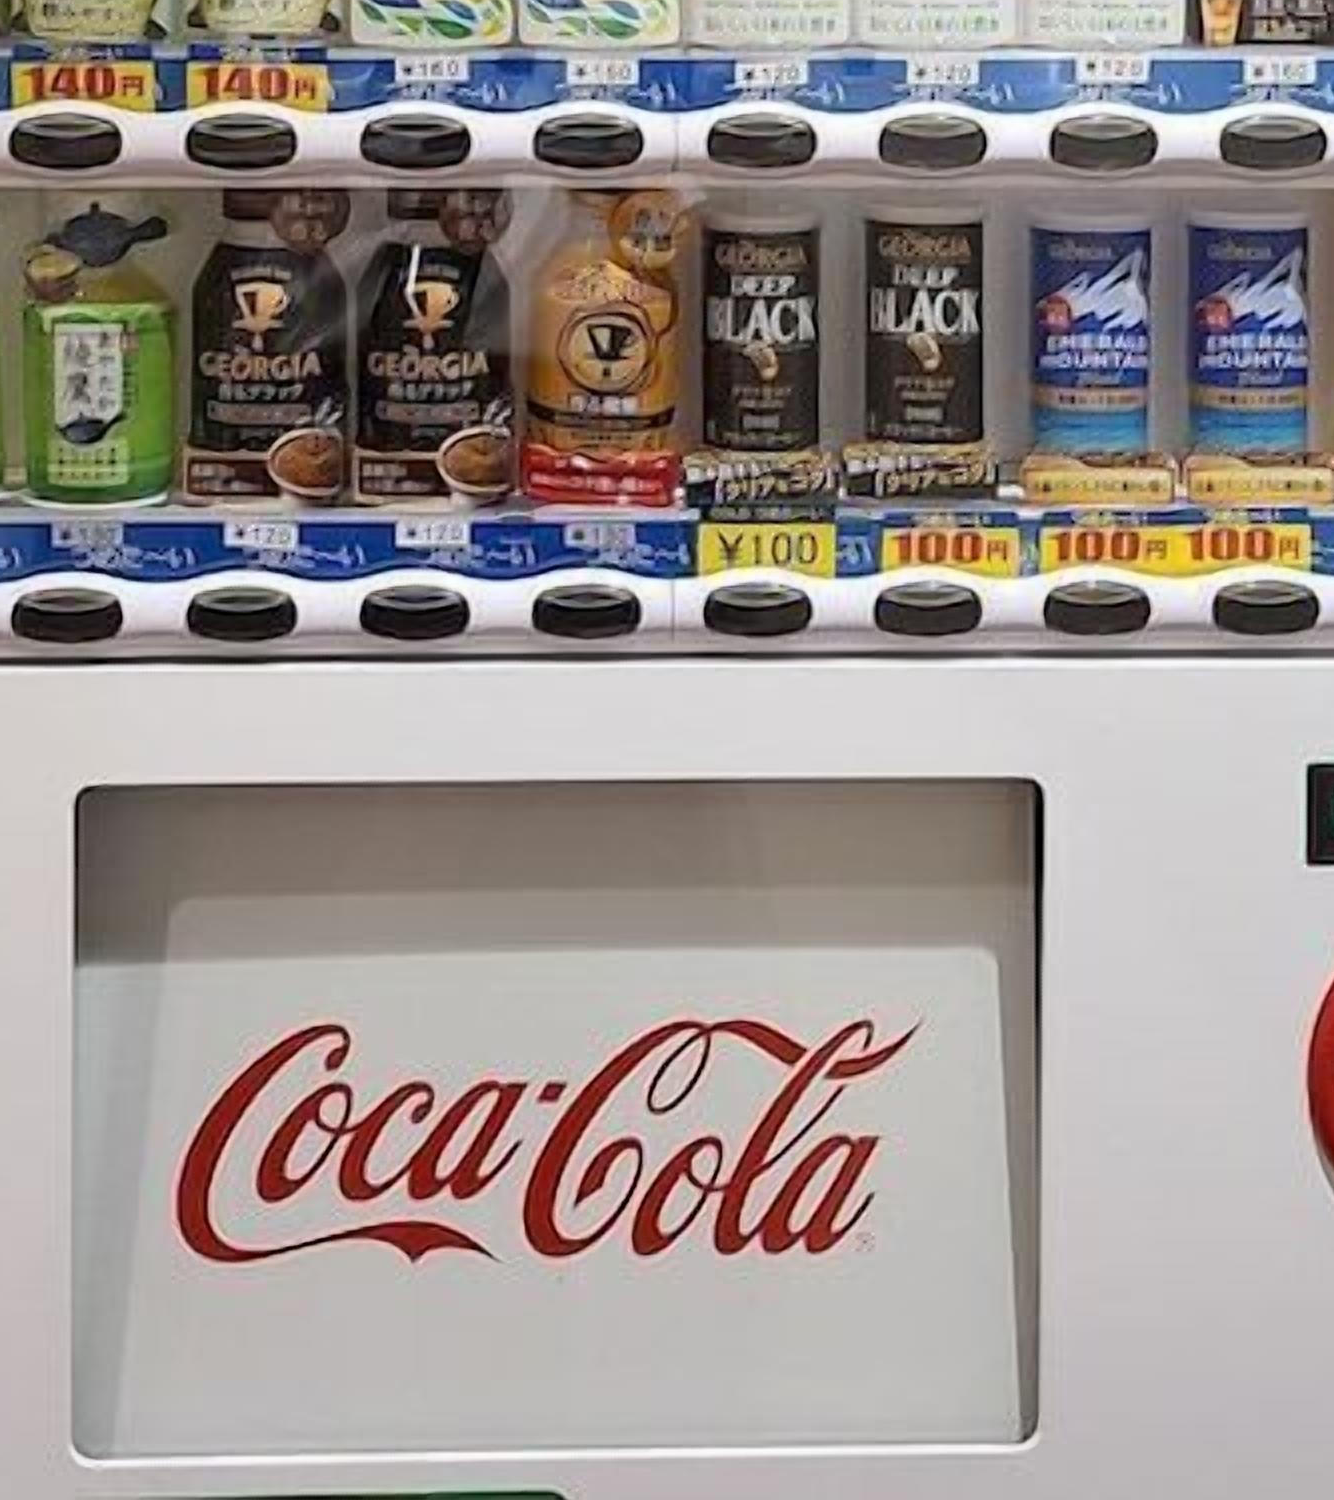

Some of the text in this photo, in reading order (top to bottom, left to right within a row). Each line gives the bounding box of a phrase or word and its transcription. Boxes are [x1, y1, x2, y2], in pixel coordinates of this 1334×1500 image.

[24, 64, 146, 100] 140円
[201, 64, 318, 100] 140円
[705, 296, 817, 343] BLACK
[869, 286, 982, 336] BLACK
[198, 346, 323, 382] GEORGIA
[365, 345, 490, 382] GEORGIA
[718, 532, 819, 565] ¥100
[893, 531, 1012, 564] 100円
[1050, 529, 1167, 564] 100円
[1184, 529, 1300, 563] 100円
[175, 1017, 925, 1265] Coca-Cola
